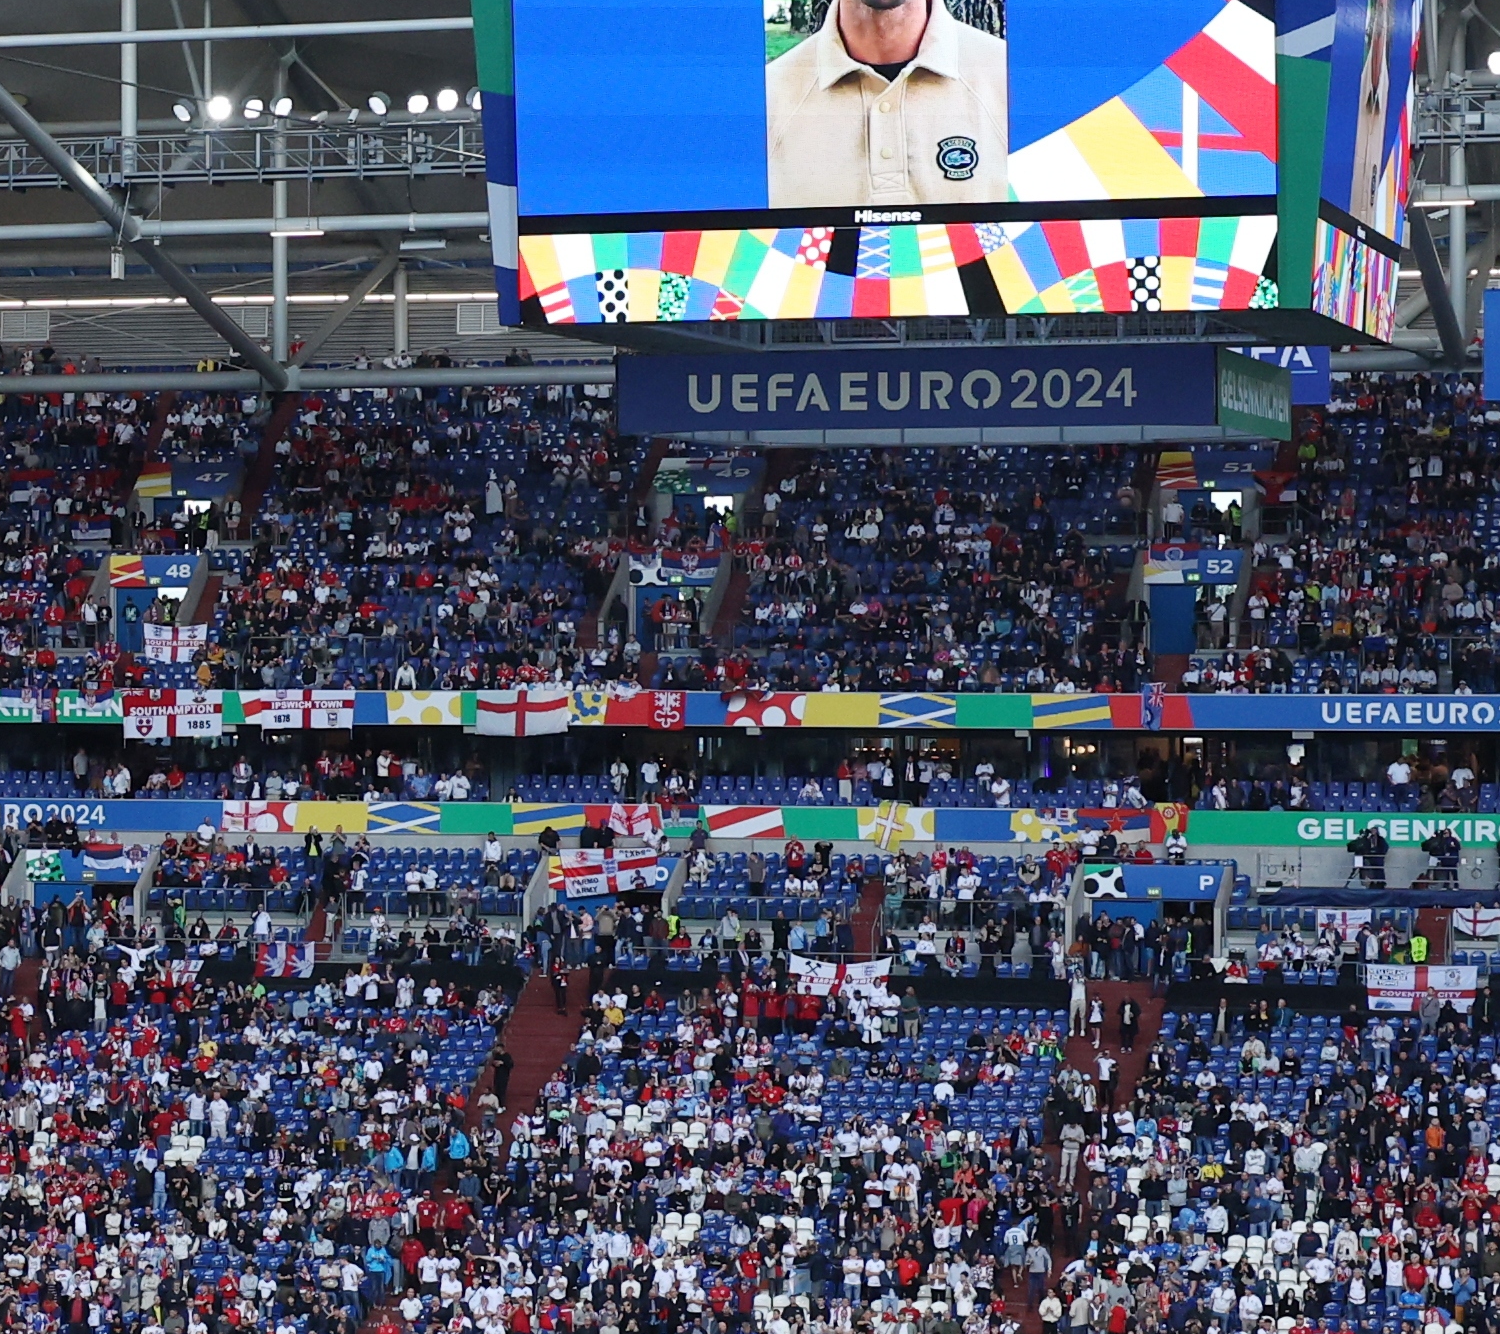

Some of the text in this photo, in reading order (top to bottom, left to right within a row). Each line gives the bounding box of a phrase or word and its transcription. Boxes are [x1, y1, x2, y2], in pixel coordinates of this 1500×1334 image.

[854, 209, 923, 223] Hisense
[1221, 366, 1289, 423] GELSENKIRCHEN
[195, 472, 229, 482] 47
[166, 564, 191, 578] 48
[1206, 559, 1234, 574] 52
[130, 704, 214, 716] SOUTHAMPTON
[271, 700, 343, 709] IPSWICH TOWN
[187, 720, 211, 729] 1885
[1200, 875, 1214, 891] P
[576, 885, 598, 894] ARMY
[1437, 990, 1462, 999] CITY
